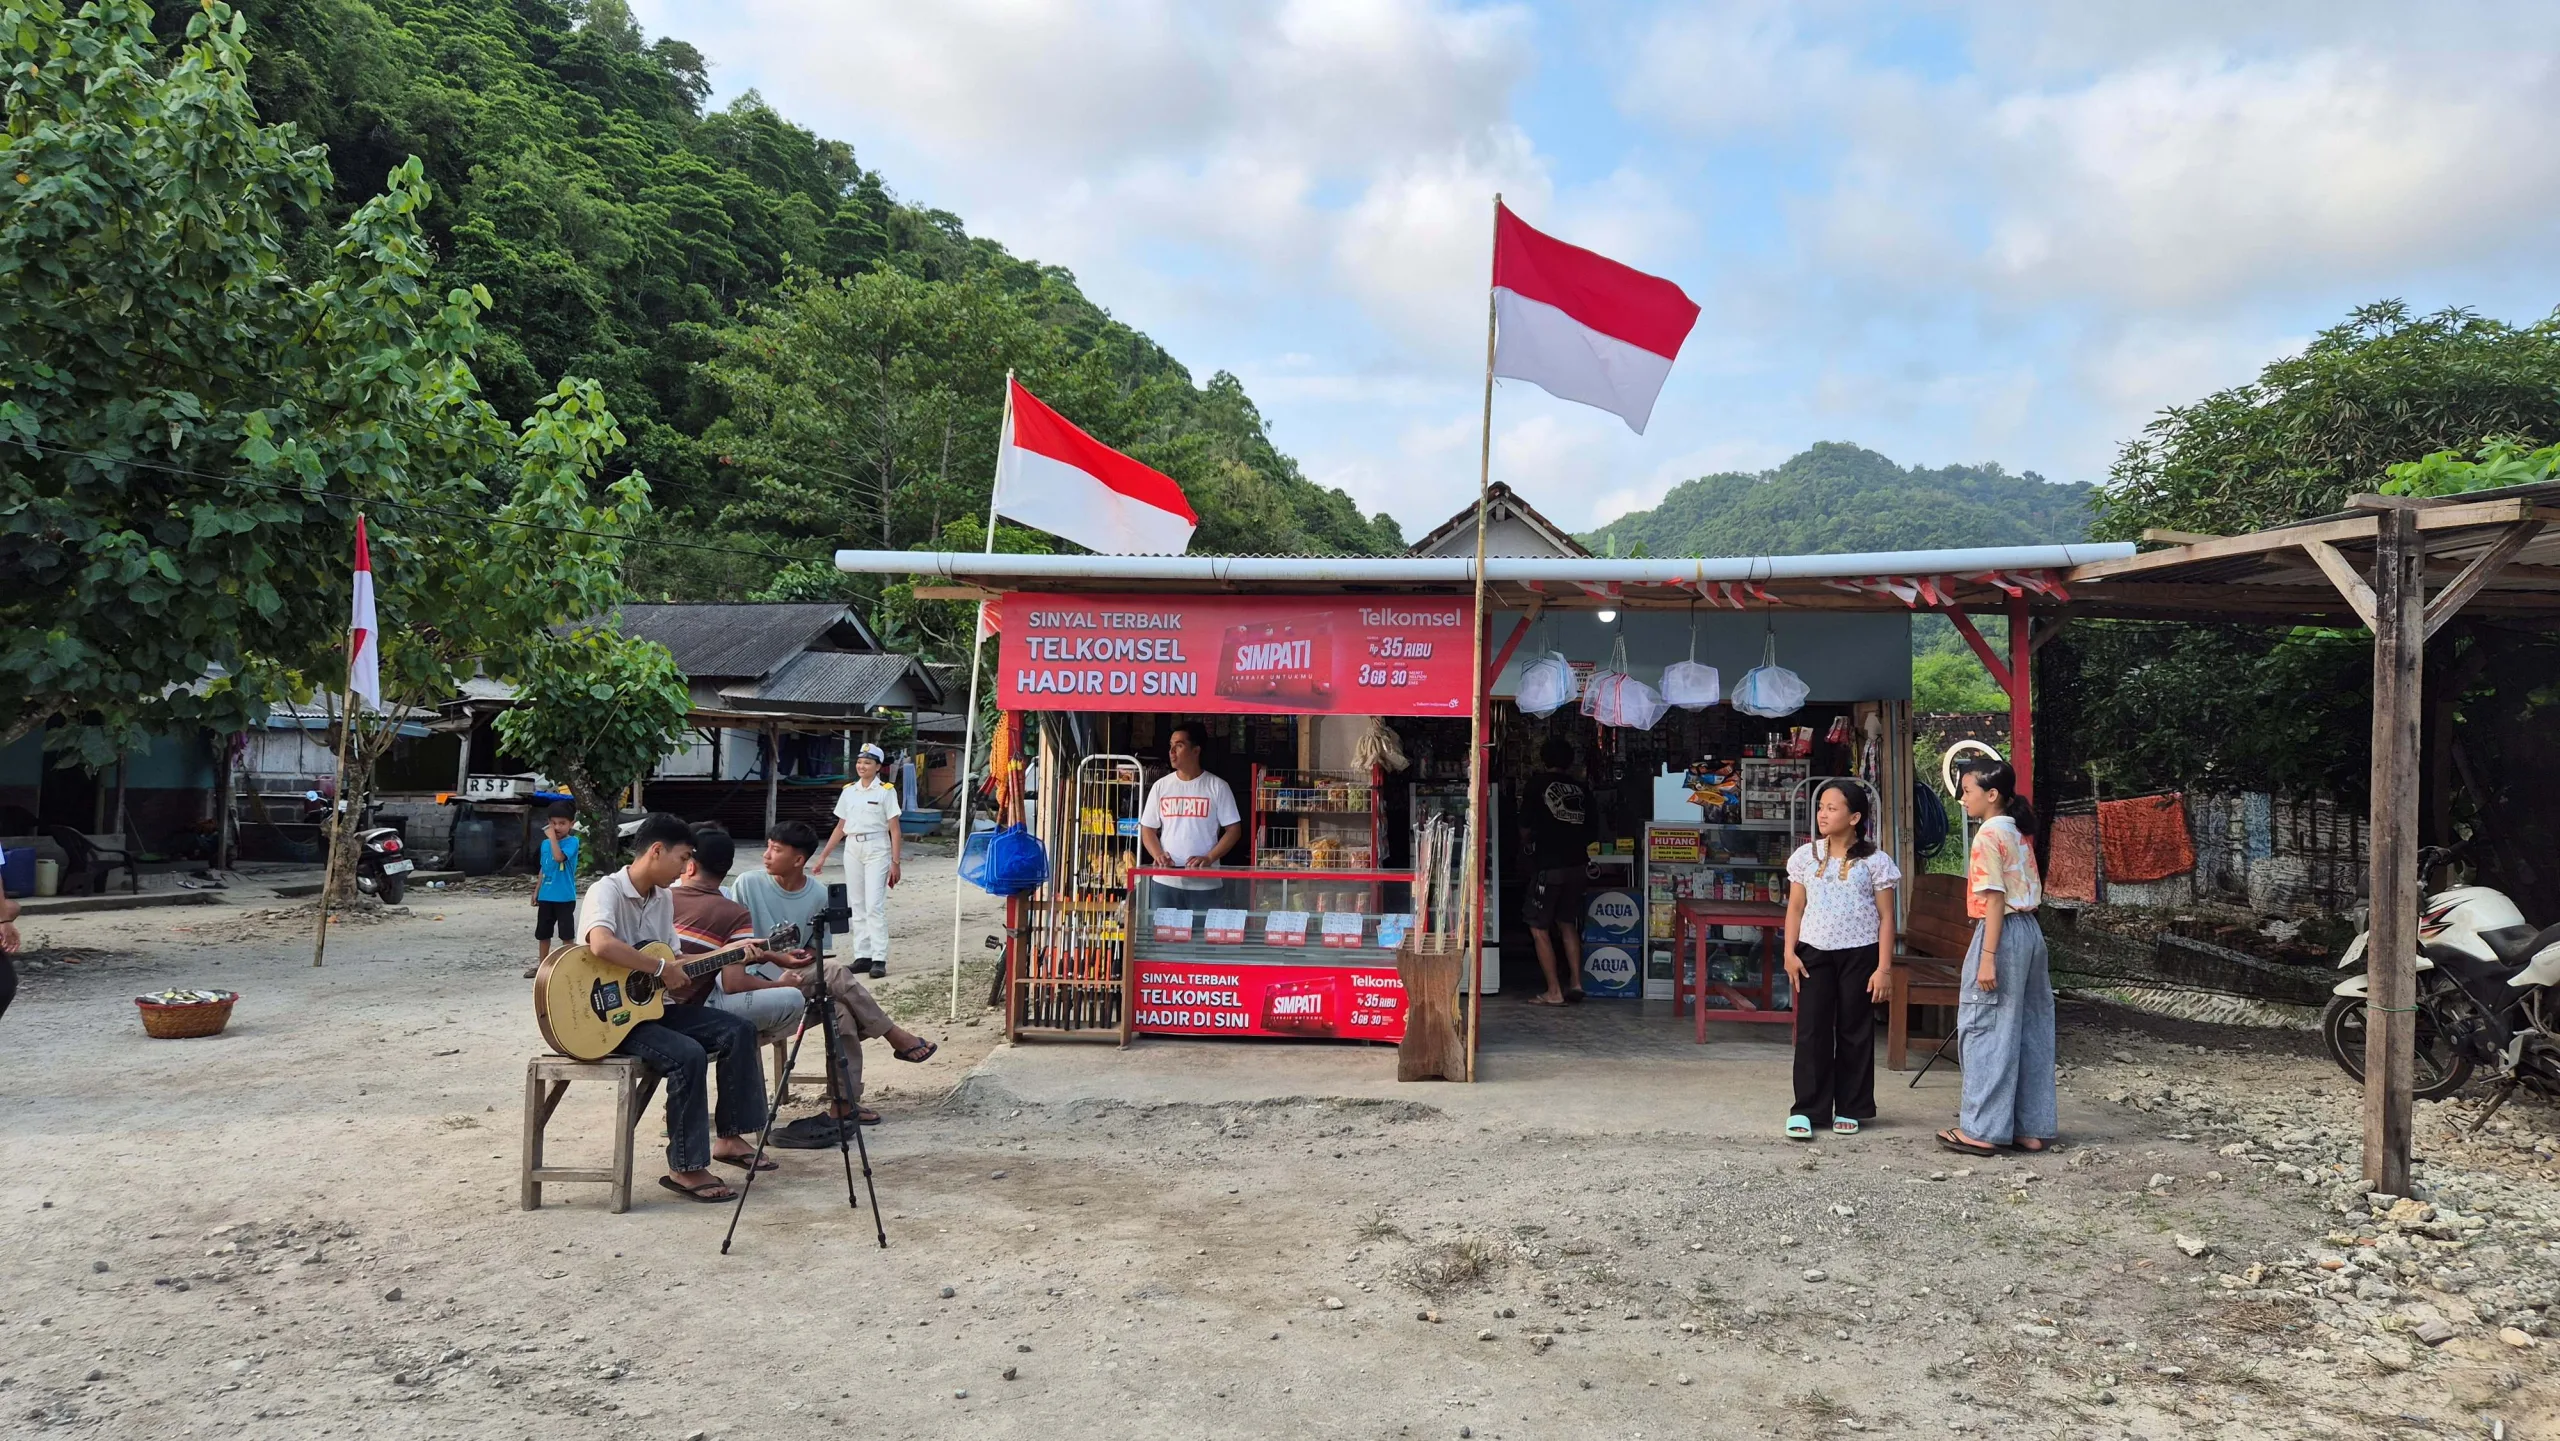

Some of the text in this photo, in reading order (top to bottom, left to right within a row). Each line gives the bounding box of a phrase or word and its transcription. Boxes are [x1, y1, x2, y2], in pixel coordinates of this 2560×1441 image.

[1029, 612, 1182, 629] SINYAL TERBAIK
[1359, 608, 1460, 626] Telkomsel
[1026, 637, 1186, 661] TELKOMSEL
[1236, 640, 1310, 671] SIMPATI
[1370, 637, 1432, 657] Rp 35 RIBU
[1017, 670, 1197, 695] HADIR DI SINI
[1391, 670, 1406, 685] 30
[1161, 799, 1208, 816] SIMPATI
[1595, 903, 1633, 918] AQUA
[1591, 958, 1629, 973] AQUA
[1142, 973, 1239, 986] SINYAL TERBAIK
[1351, 974, 1404, 988] Telkoms
[1141, 989, 1242, 1007] TELKOMSEL
[1273, 994, 1321, 1014] SIMPATI
[1364, 994, 1379, 1007] 35
[1379, 998, 1397, 1008] RIBU
[1135, 1010, 1249, 1028] HADIR DI SINI
[1371, 1015, 1381, 1025] 30
